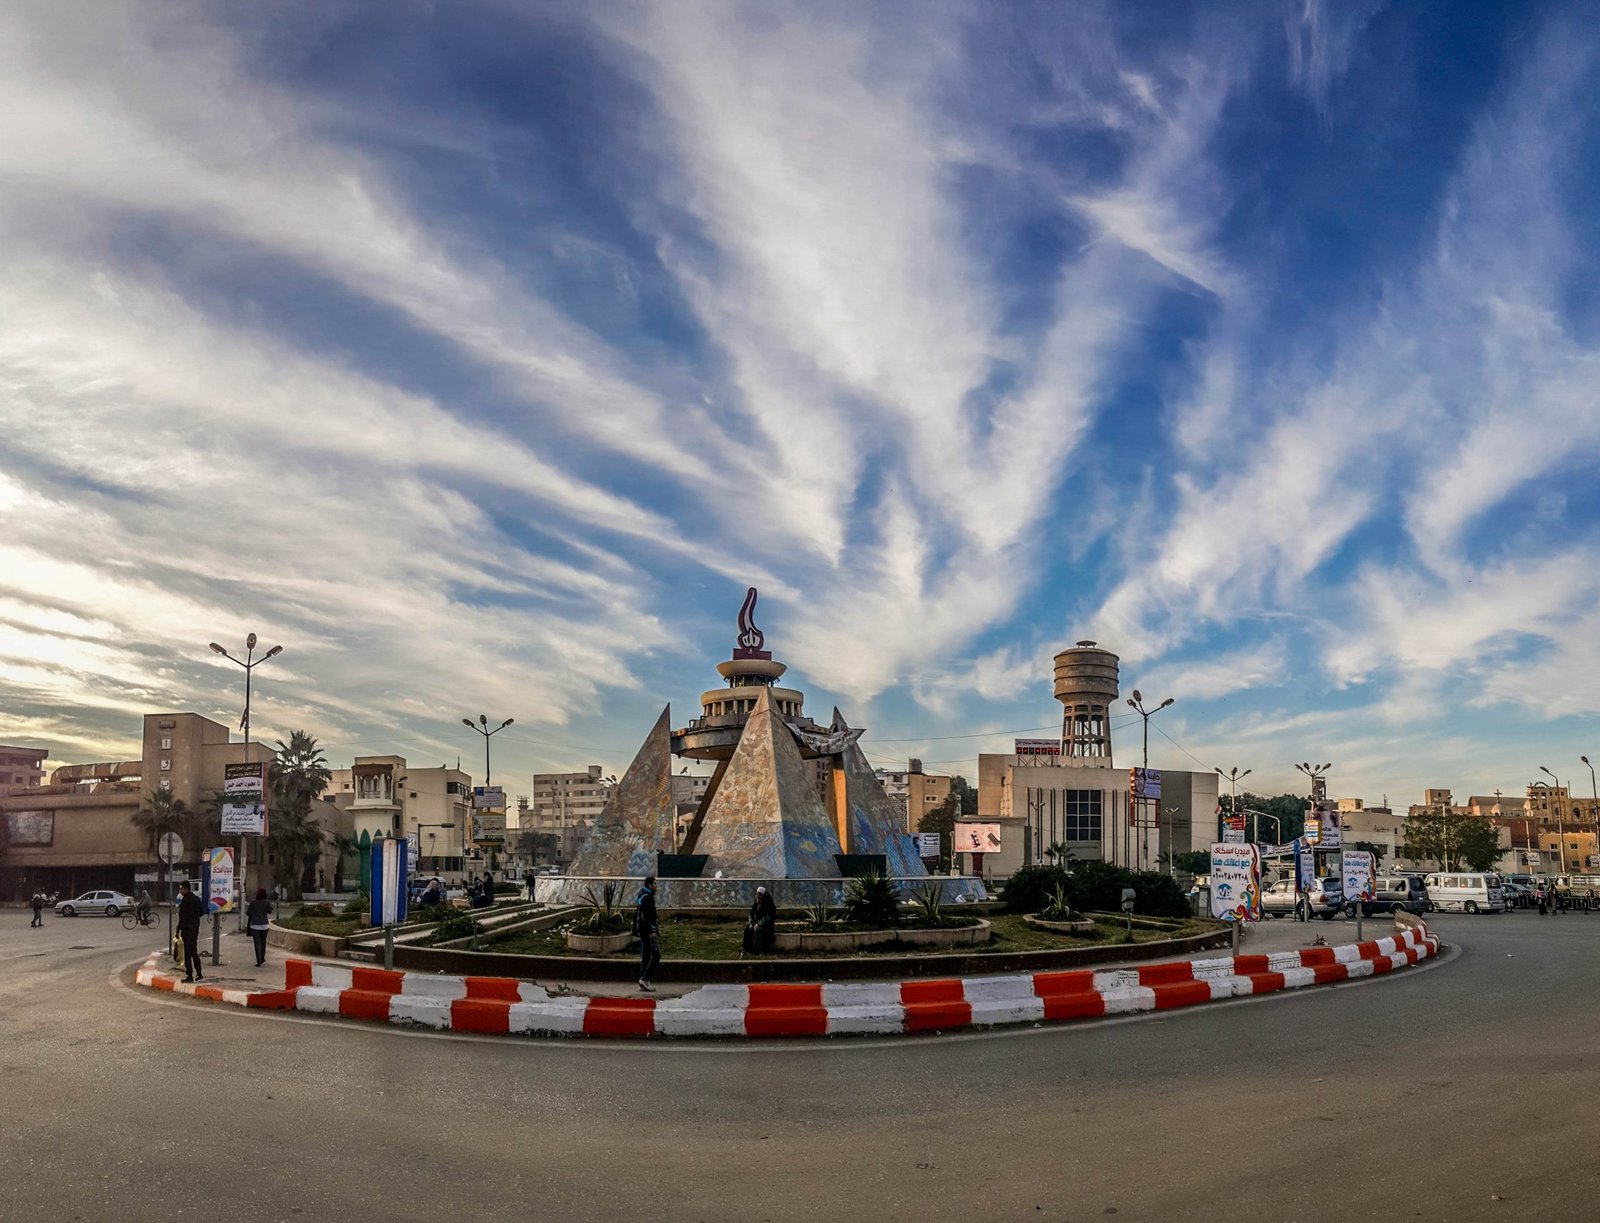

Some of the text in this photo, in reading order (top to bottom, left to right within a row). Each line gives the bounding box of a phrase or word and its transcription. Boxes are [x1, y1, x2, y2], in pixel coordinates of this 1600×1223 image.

[1235, 848, 1250, 857] ميديا
[1212, 857, 1223, 866] هنا
[1241, 858, 1250, 870] ضع
